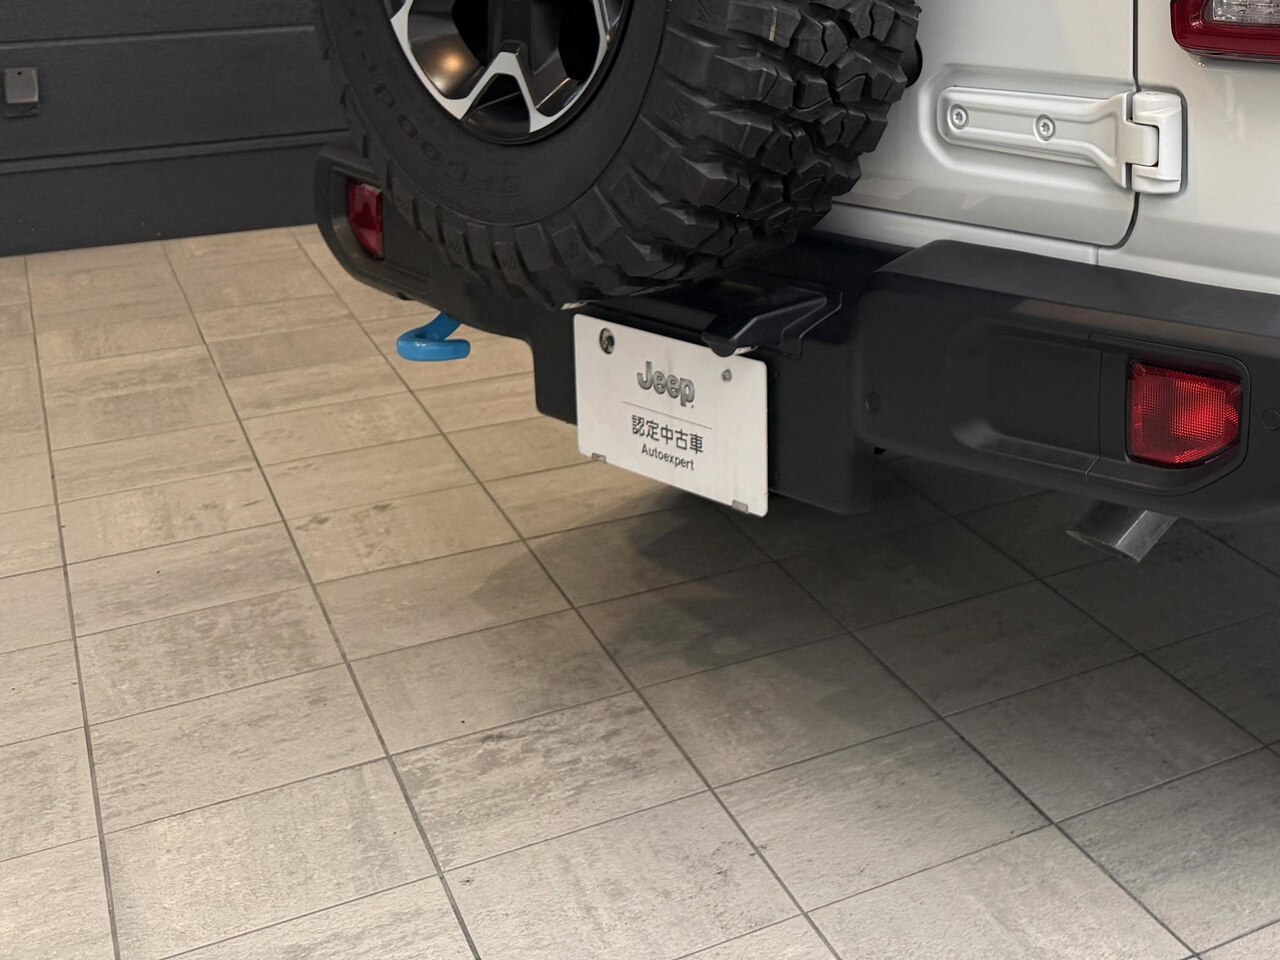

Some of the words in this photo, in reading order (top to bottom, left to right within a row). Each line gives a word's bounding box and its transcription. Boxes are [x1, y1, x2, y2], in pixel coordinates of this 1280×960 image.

[636, 360, 696, 408] Jeep
[631, 414, 704, 455] 認定中古車
[641, 443, 695, 471] Autoexpert
